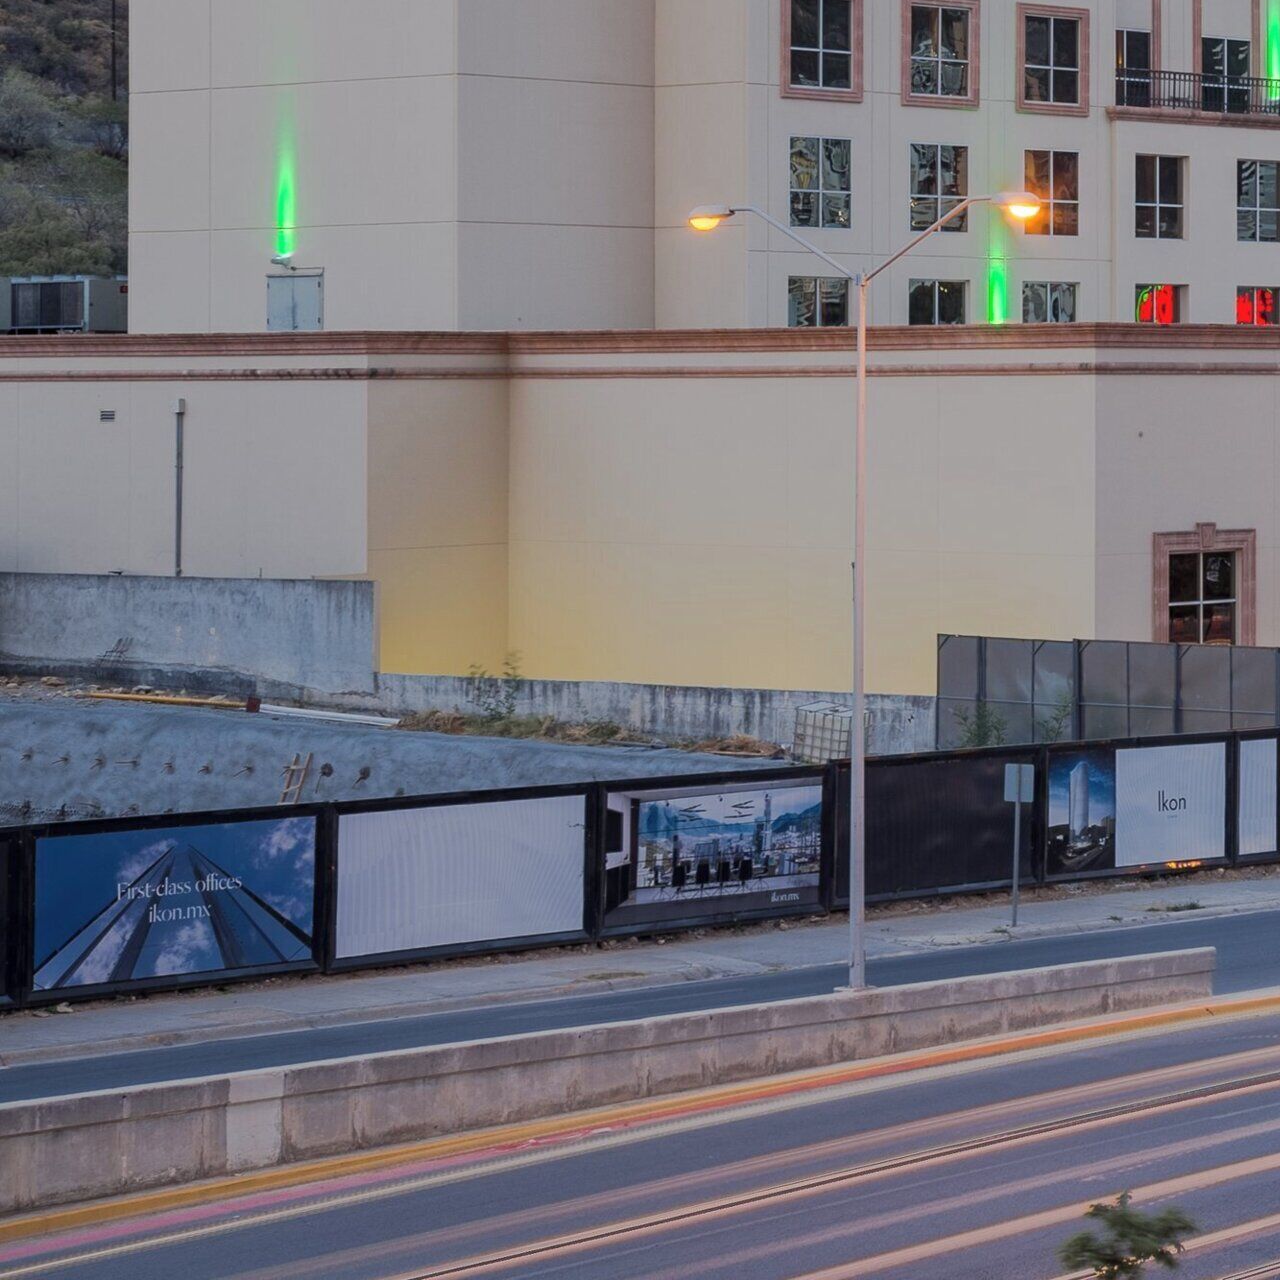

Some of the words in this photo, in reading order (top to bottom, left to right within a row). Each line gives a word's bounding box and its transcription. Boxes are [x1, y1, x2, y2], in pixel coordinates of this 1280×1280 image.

[1158, 790, 1187, 811] Ikon
[117, 877, 192, 901] First-class
[195, 872, 243, 892] offices
[149, 904, 212, 923] ikon.mx
